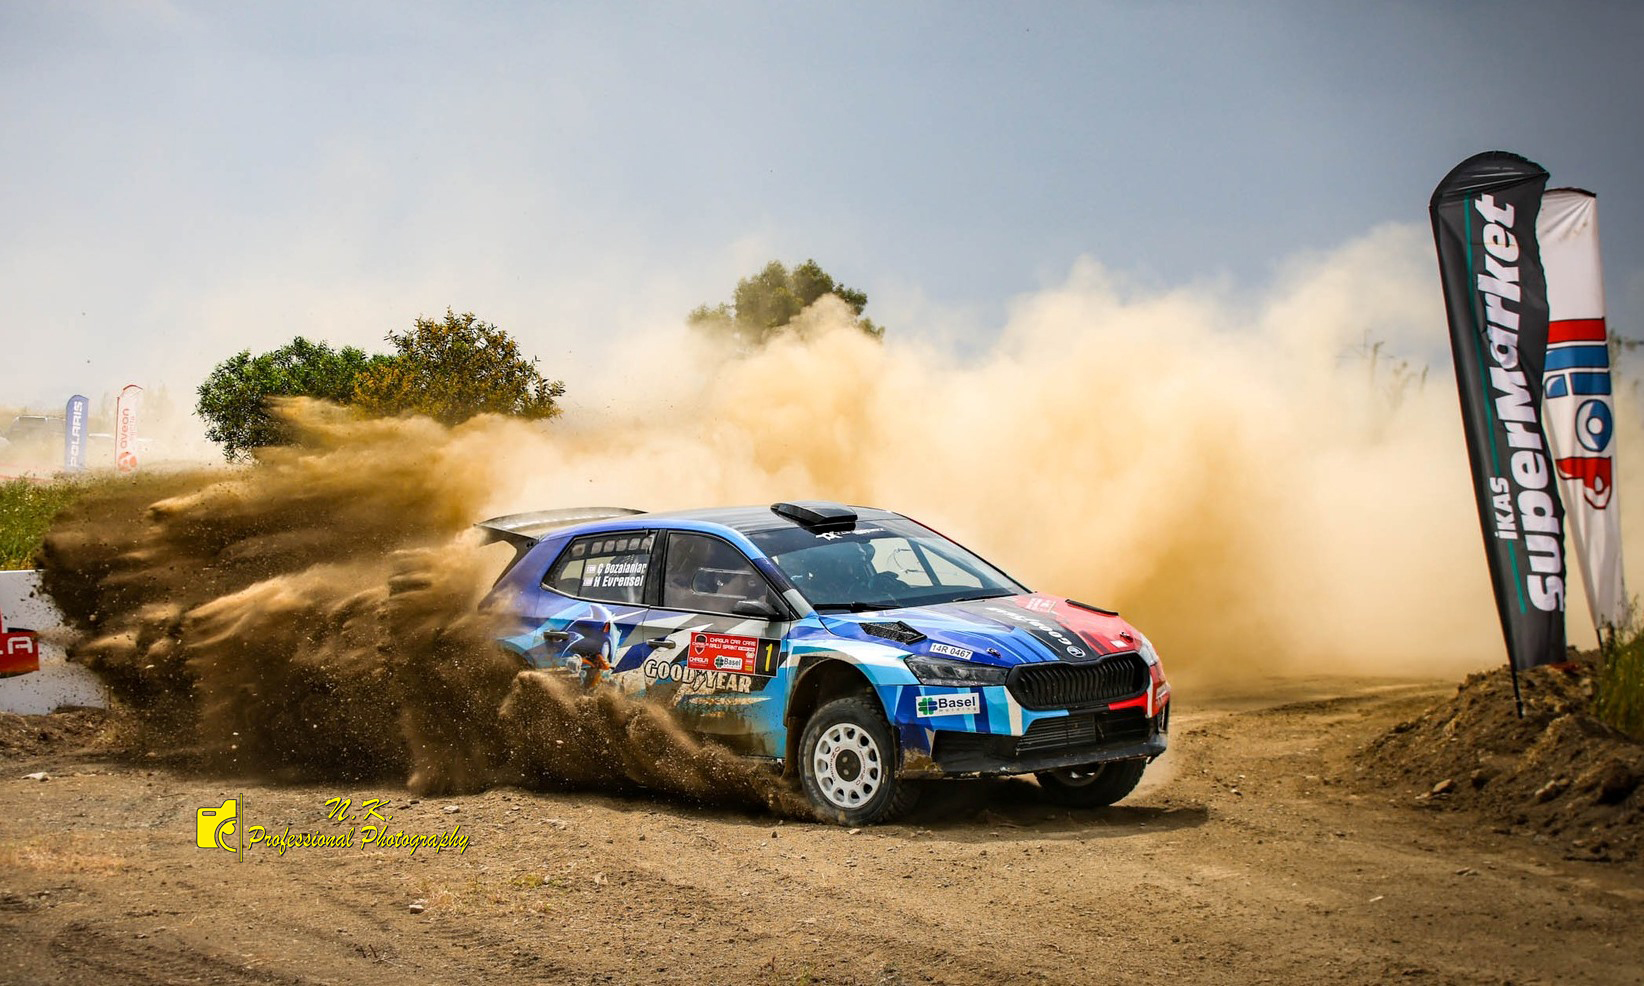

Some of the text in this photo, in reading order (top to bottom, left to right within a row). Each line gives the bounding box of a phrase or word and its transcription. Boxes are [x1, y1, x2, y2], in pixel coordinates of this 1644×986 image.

[69, 400, 83, 467] POLARIS
[1490, 477, 1519, 540] İKAS
[593, 575, 644, 587] H Evrensel
[765, 643, 773, 672] 1
[932, 644, 971, 658] 14R 0467
[723, 658, 741, 666] Basel
[644, 659, 752, 694] GOODYEAR
[938, 696, 976, 709] Basel
